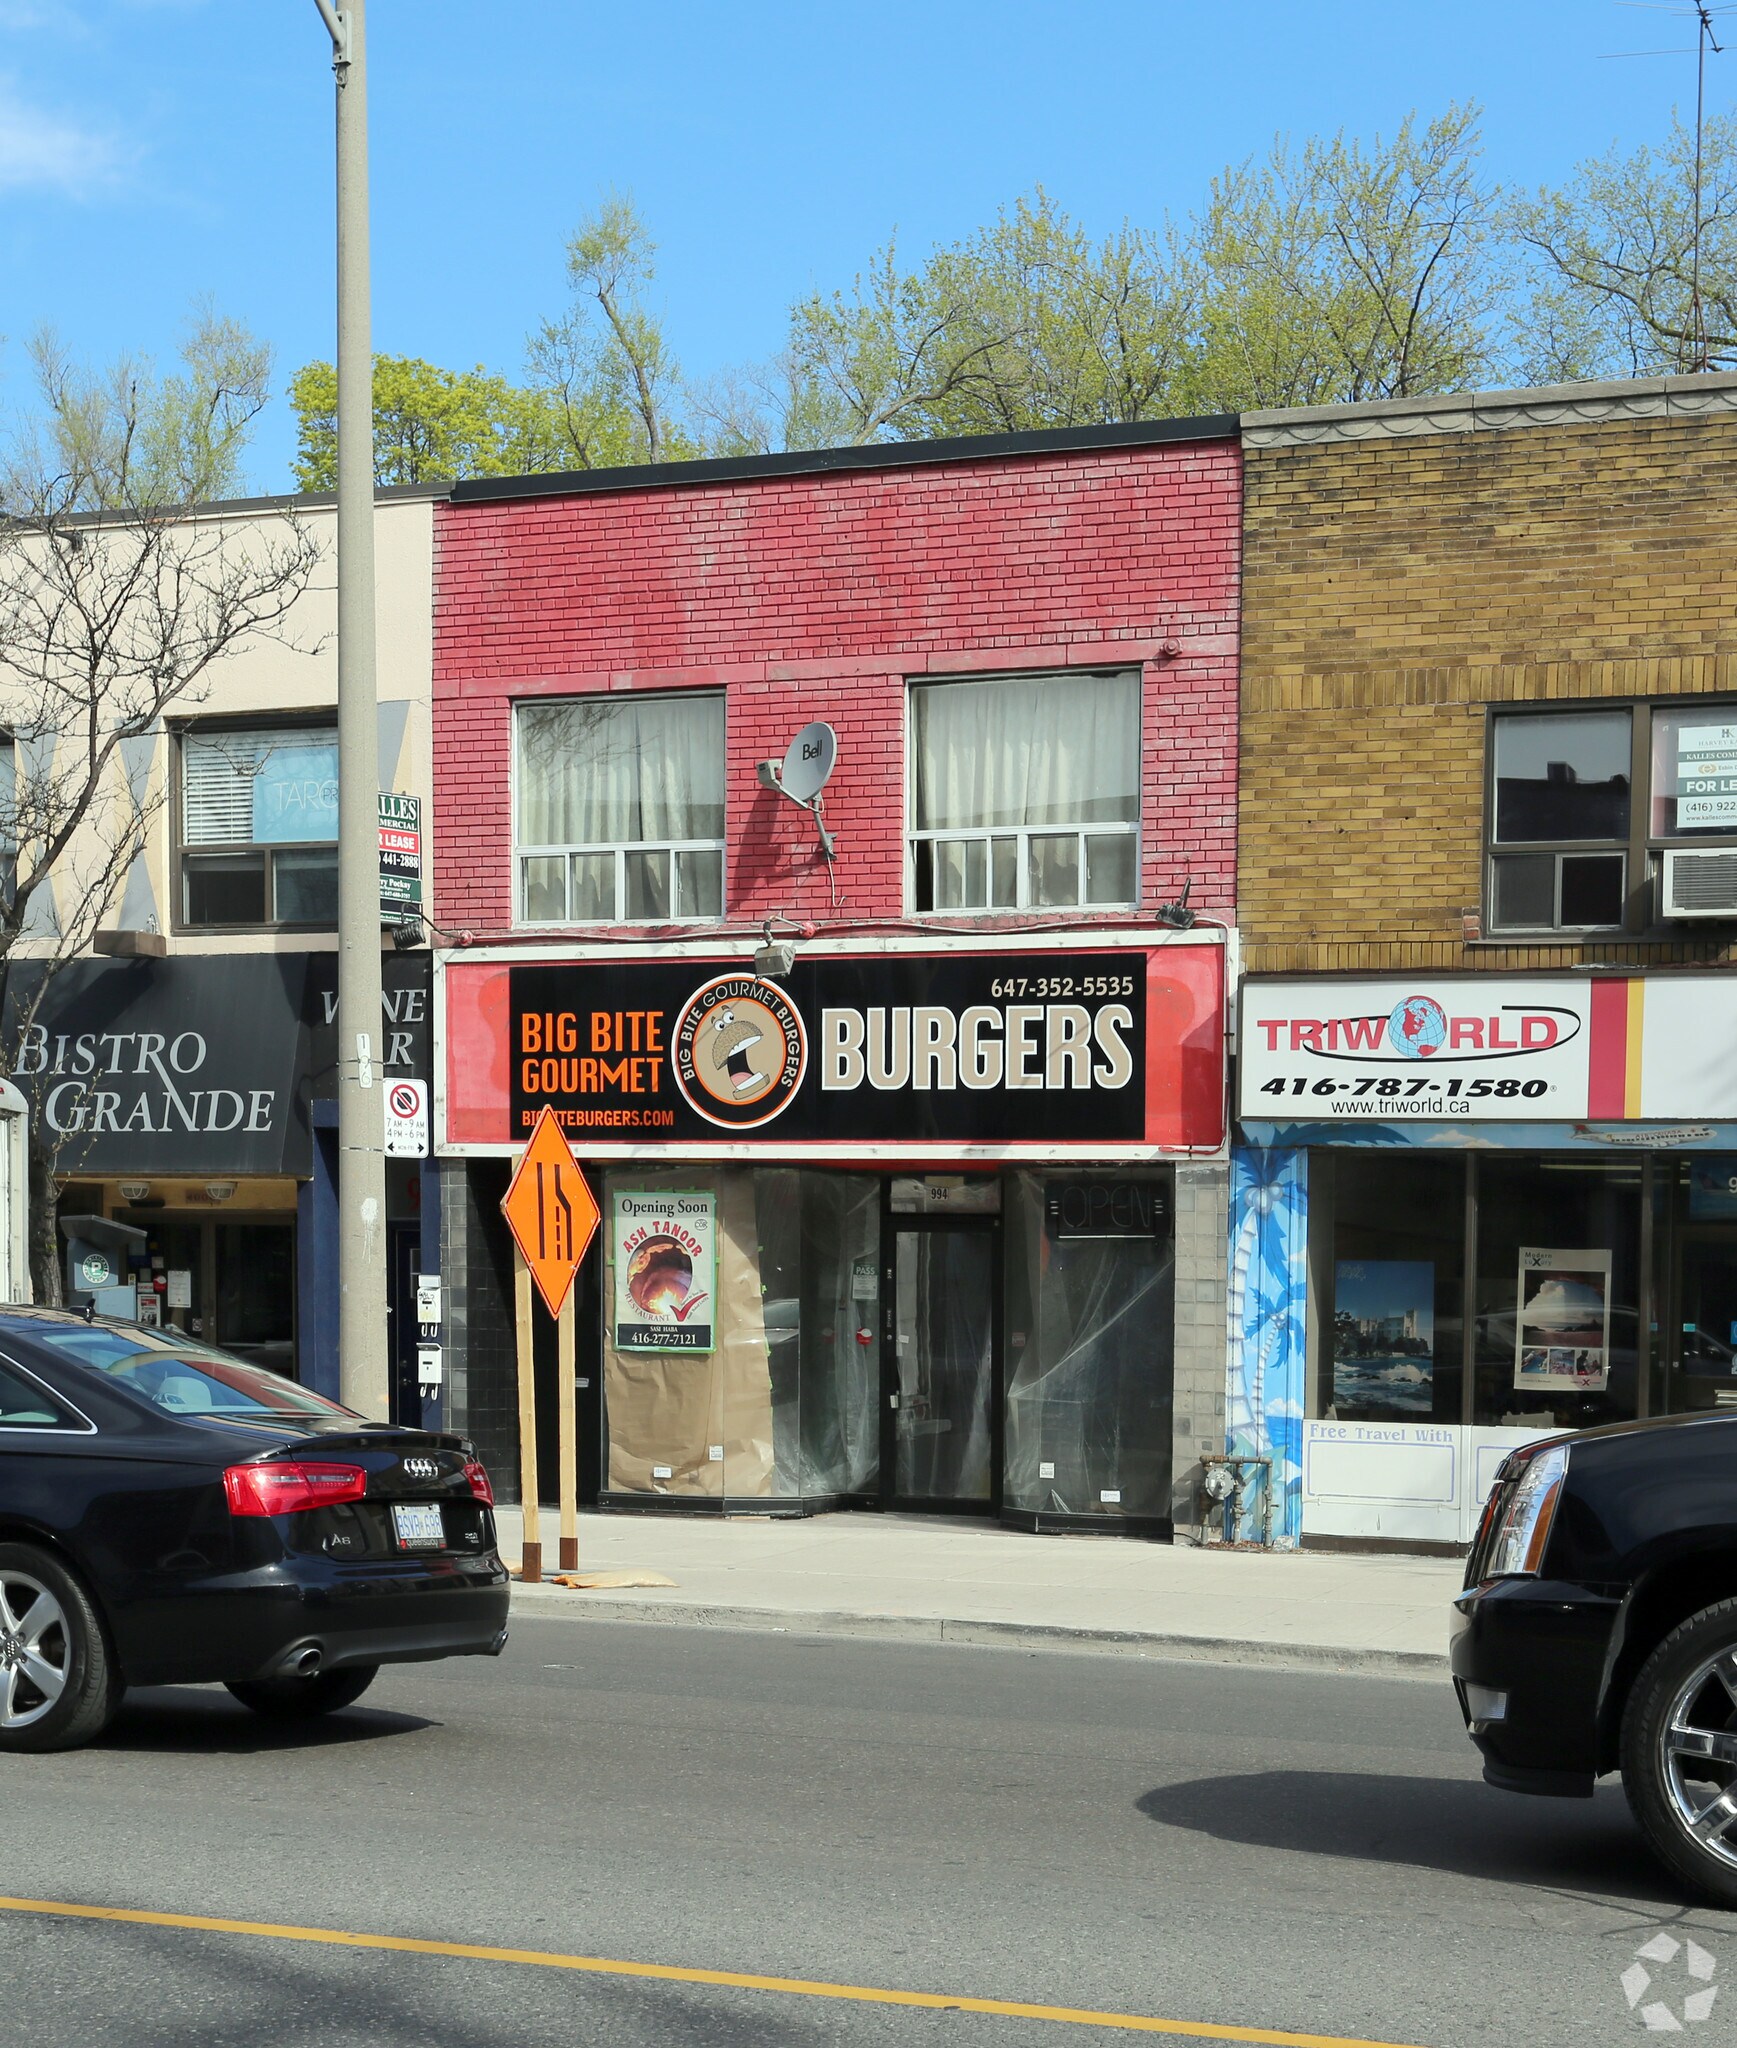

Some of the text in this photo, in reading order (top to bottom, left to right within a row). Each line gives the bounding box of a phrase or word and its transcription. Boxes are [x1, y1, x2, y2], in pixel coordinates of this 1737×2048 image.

[802, 739, 822, 760] Bell
[1686, 752, 1715, 760] KALLES
[1686, 781, 1716, 792] FOR
[378, 796, 417, 820] LLES
[1686, 803, 1713, 813] (416)
[380, 818, 417, 831] MERCIAL
[385, 833, 415, 850] LEASE
[382, 852, 419, 869] 441-2888
[990, 976, 1134, 997] 647-352-5535
[522, 1011, 664, 1053] BIG BITE
[679, 982, 800, 1088] BIG BITE GOURMET BURGERS
[10, 1023, 208, 1076] BISTRO
[821, 1004, 1134, 1091] BURGERS
[522, 1057, 664, 1093] GOURMET
[45, 1081, 275, 1132] GRANDE
[1331, 1097, 1471, 1114] www.triworld.ca
[409, 1118, 414, 1128] 9
[522, 1110, 674, 1126] BITEBURGERS.COM
[387, 1129, 392, 1137] 4
[394, 1130, 402, 1138] PM
[409, 1130, 414, 1138] 6
[416, 1131, 425, 1139] PM
[931, 1188, 948, 1200] 994
[622, 1199, 708, 1217] Opening Soon
[1062, 1184, 1151, 1228] OPEN
[623, 1221, 703, 1257] ASH TANOOR
[856, 1266, 875, 1275] PASS
[625, 1292, 671, 1322] RESTAURANT
[632, 1332, 696, 1345] 416-277-7121
[1310, 1423, 1453, 1442] Free Travel With
[331, 1533, 351, 1546] A6
